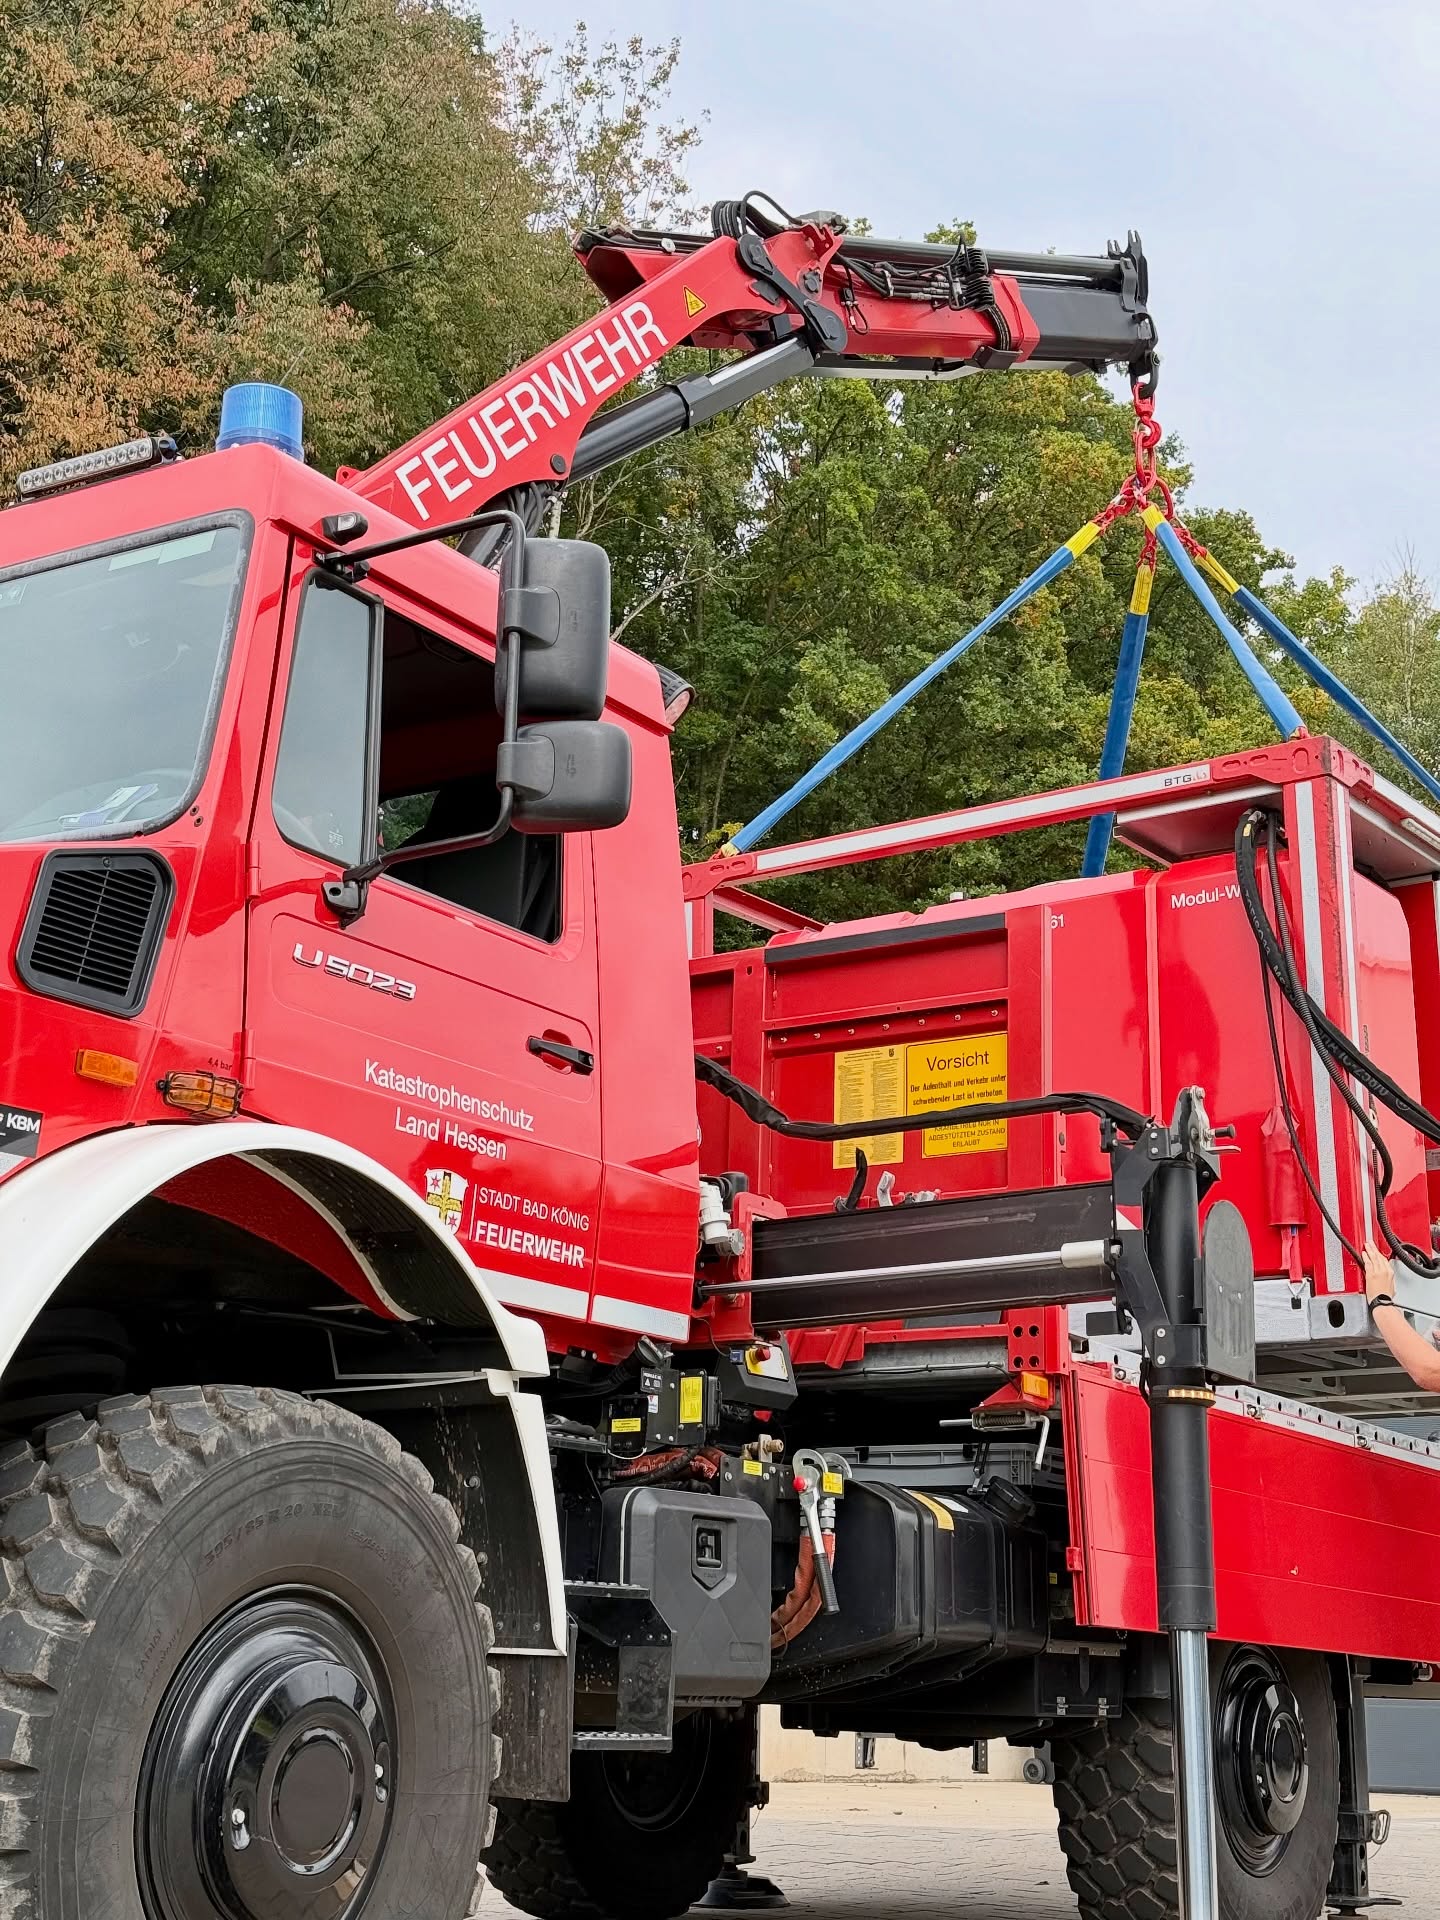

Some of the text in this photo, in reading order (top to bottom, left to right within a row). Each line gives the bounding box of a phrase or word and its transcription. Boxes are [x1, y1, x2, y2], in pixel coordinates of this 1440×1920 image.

[394, 301, 669, 522] FEUERWEHR
[1164, 774, 1192, 787] BTG
[292, 942, 417, 1002] U 5023
[220, 1061, 232, 1071] bar
[926, 1051, 990, 1072] Vorsicht
[365, 1058, 535, 1132] Katastrophenschutz
[910, 1085, 921, 1093] Der
[953, 1079, 965, 1087] und
[966, 1076, 989, 1086] Verkehr
[952, 1092, 965, 1102] Last
[6, 1112, 41, 1134] KBM
[395, 1107, 507, 1160] Land Hessen
[479, 1187, 590, 1231] STADT BAD KÖNIG
[475, 1220, 585, 1268] FEUERWEHR
